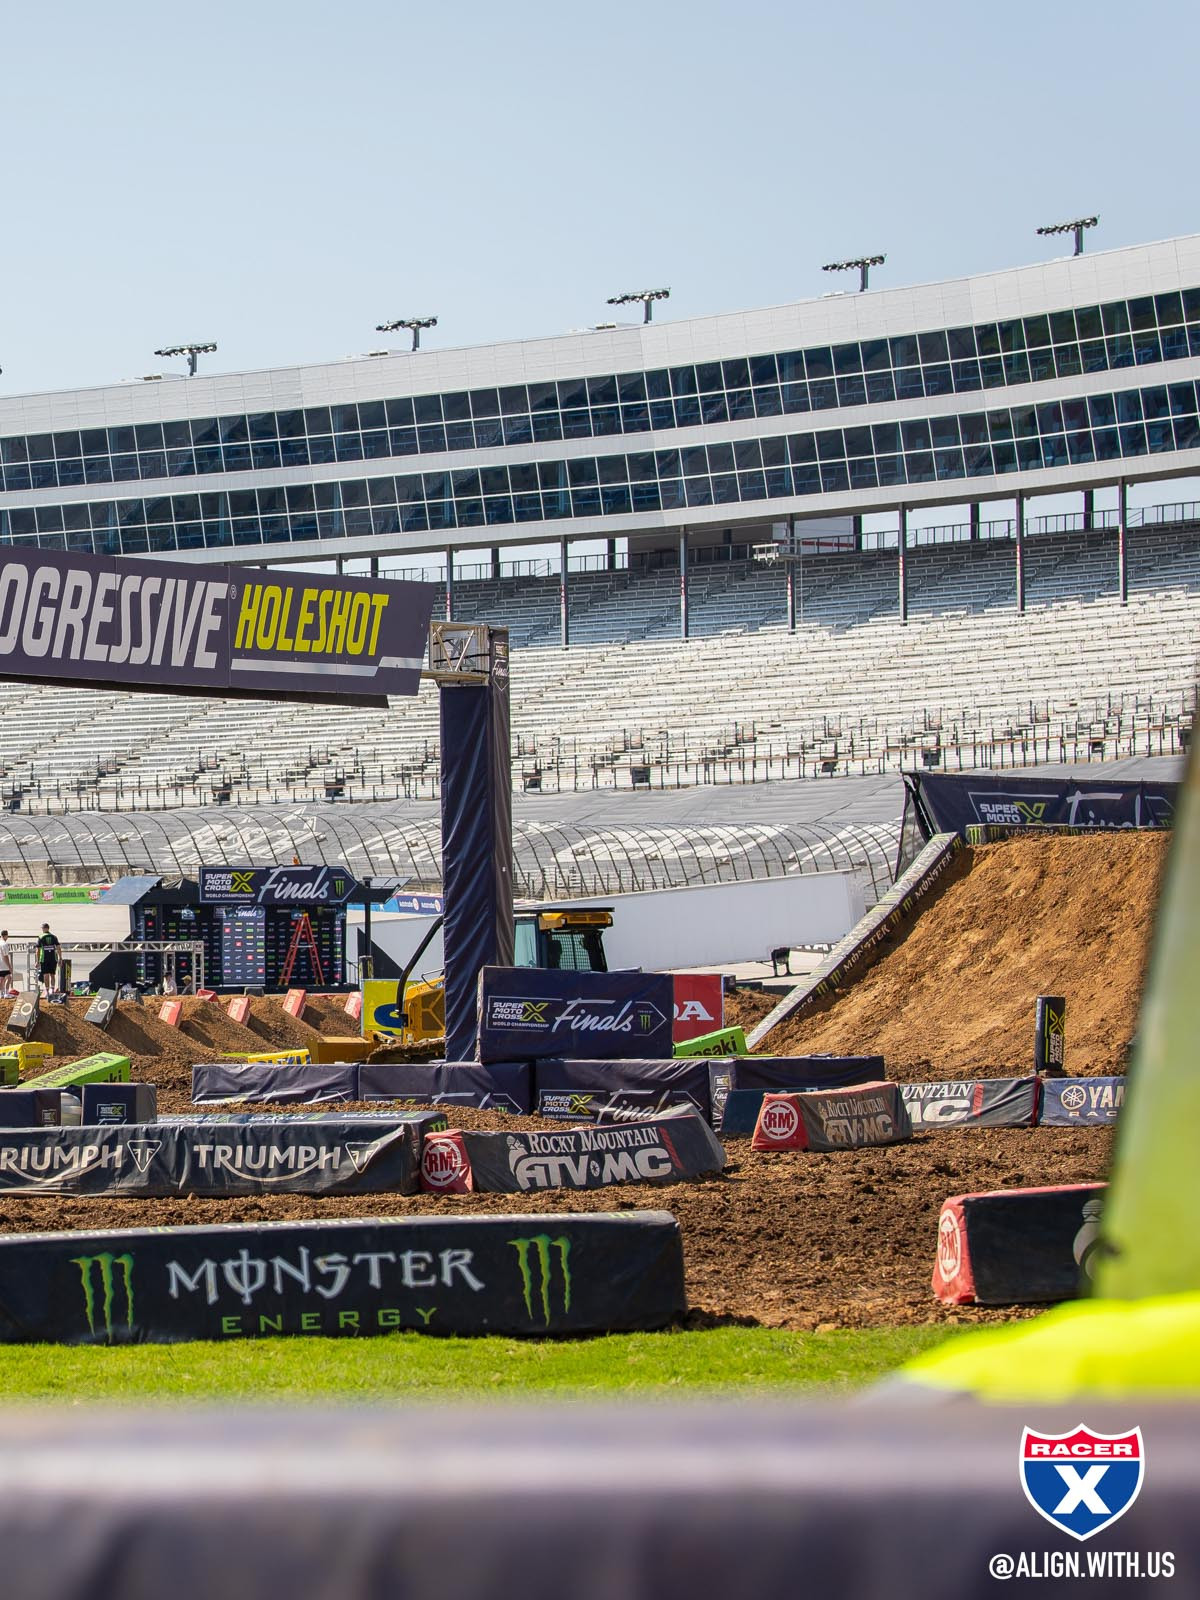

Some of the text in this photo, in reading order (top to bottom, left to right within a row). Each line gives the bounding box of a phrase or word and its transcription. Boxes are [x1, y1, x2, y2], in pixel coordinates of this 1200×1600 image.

[234, 583, 389, 656] HOLESHOT
[980, 804, 1018, 813] SUPER
[987, 814, 1020, 823] MOTO
[257, 865, 330, 902] Finals
[915, 853, 952, 899] MONSTER
[552, 998, 633, 1032] Finals
[902, 1084, 972, 1100] UNTAIN
[769, 1111, 793, 1128] RM
[193, 1145, 340, 1179] TRIUMPH
[167, 1246, 486, 1304] MONSTER
[223, 1307, 439, 1334] ENERGY
